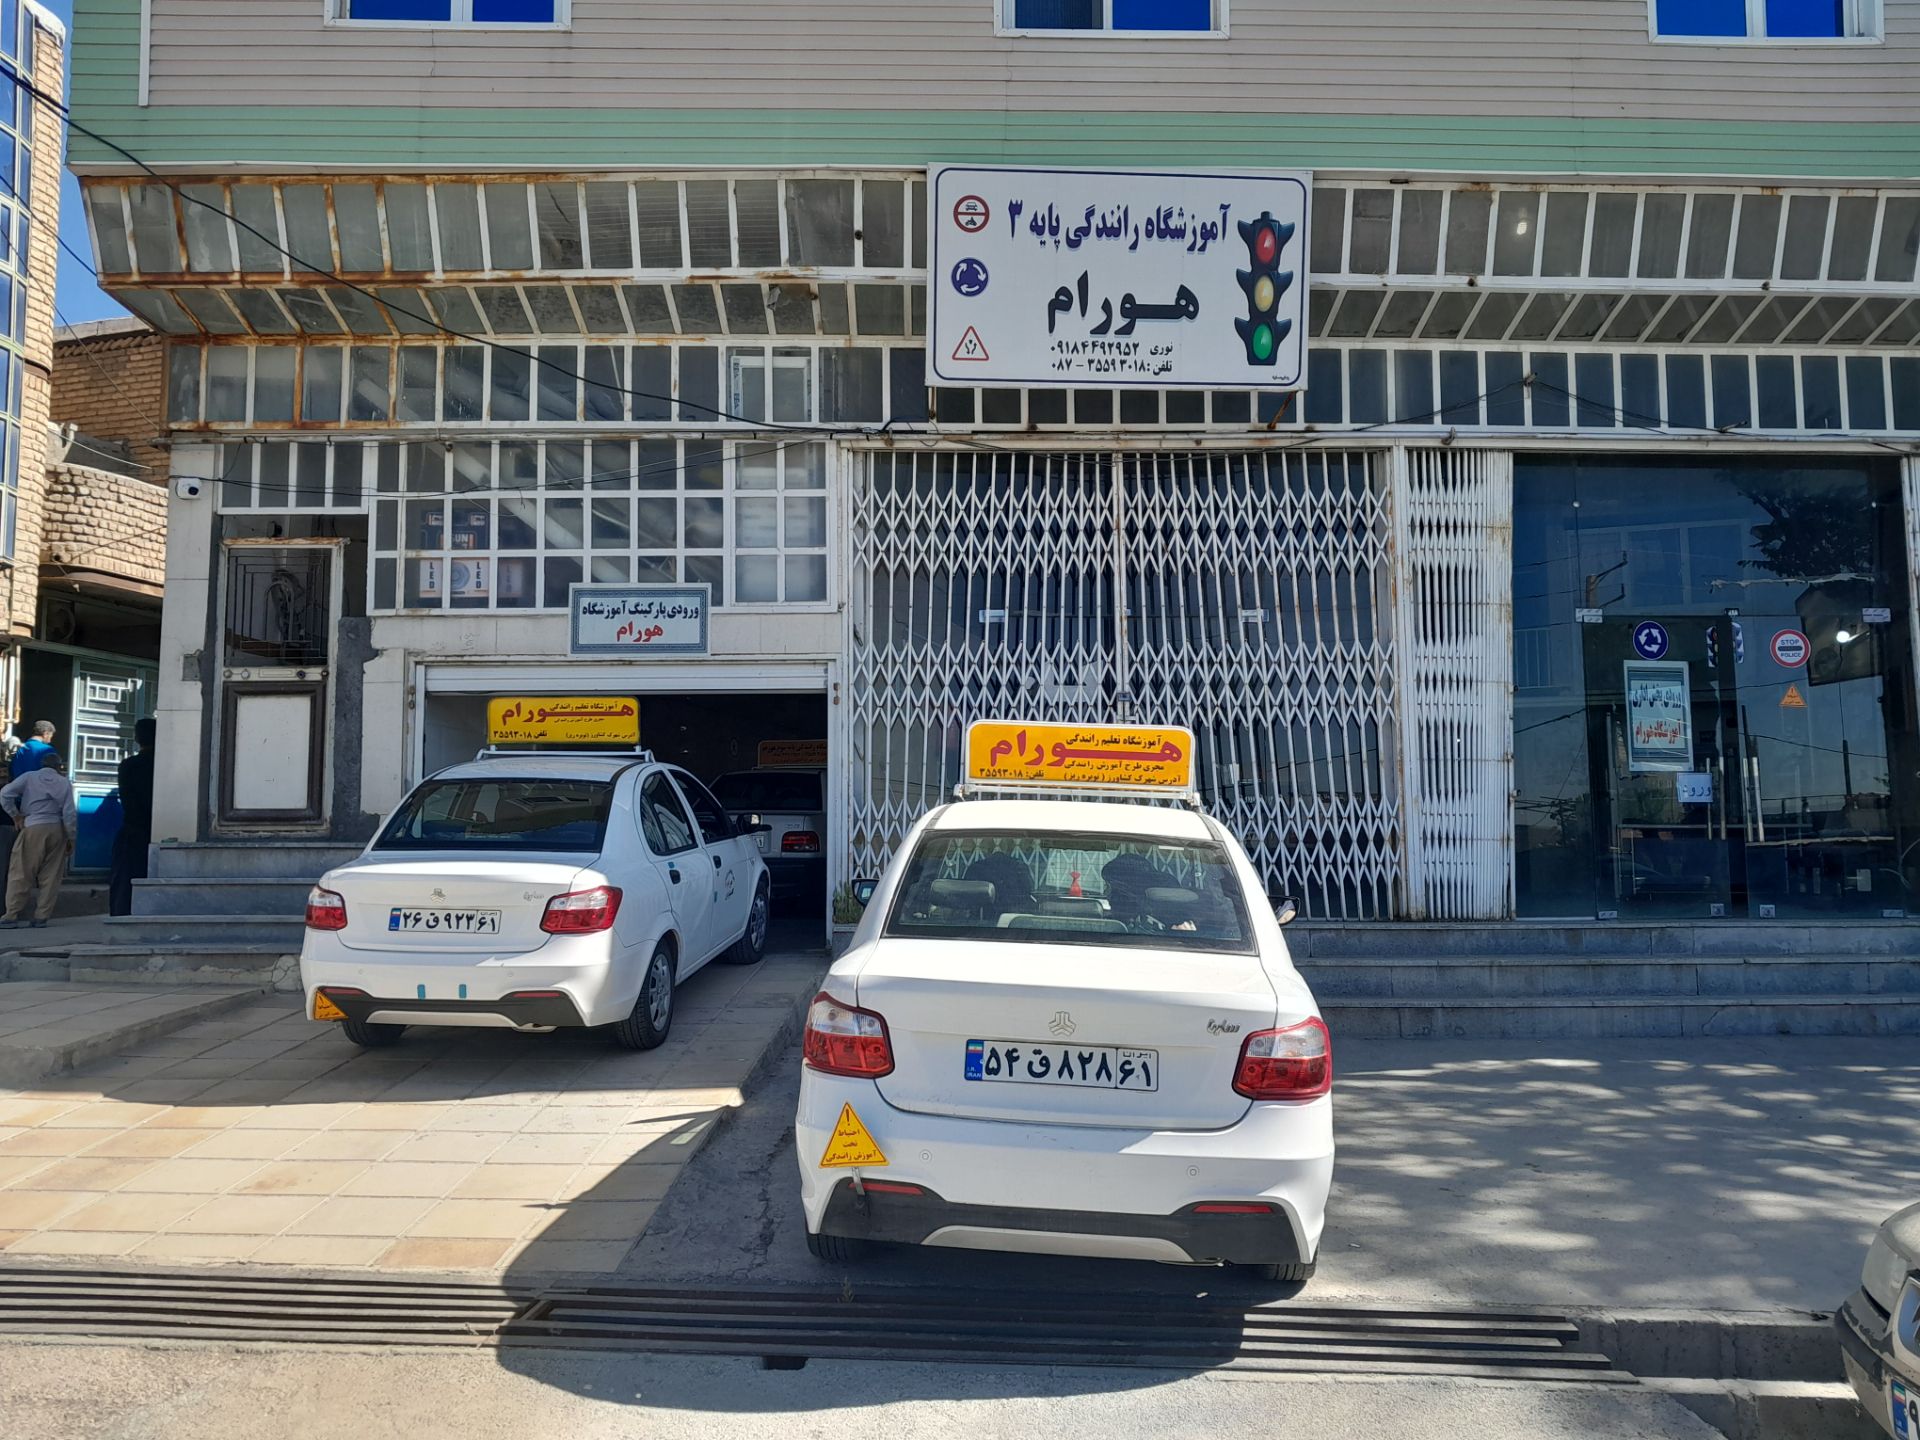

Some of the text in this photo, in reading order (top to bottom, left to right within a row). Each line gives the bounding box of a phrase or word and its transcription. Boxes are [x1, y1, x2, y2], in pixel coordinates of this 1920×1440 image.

[1008, 199, 1231, 251] آموزشگاه رانندگی پایه ۳
[1047, 270, 1200, 335] هورام
[1150, 341, 1173, 356] نوری
[582, 600, 627, 619] آموزشگاه
[667, 603, 699, 619] ورودی
[616, 621, 664, 642] هورام
[502, 701, 634, 726] هورام
[550, 703, 574, 711] رانندگی
[591, 701, 617, 711] آموزشگاه
[990, 729, 1183, 767] هورام
[1066, 733, 1162, 749] آموزشگاه تعلیم رانندگی
[979, 768, 1023, 777] ۳۵۵۹۳۰۱۸
[1064, 760, 1164, 773] مجری طرح آموزش رانندگی
[1108, 773, 1132, 783] کشاورز
[1134, 773, 1156, 784] شهرک
[1158, 774, 1181, 785] آدرس
[826, 1150, 877, 1162] آموزش رانندگی
